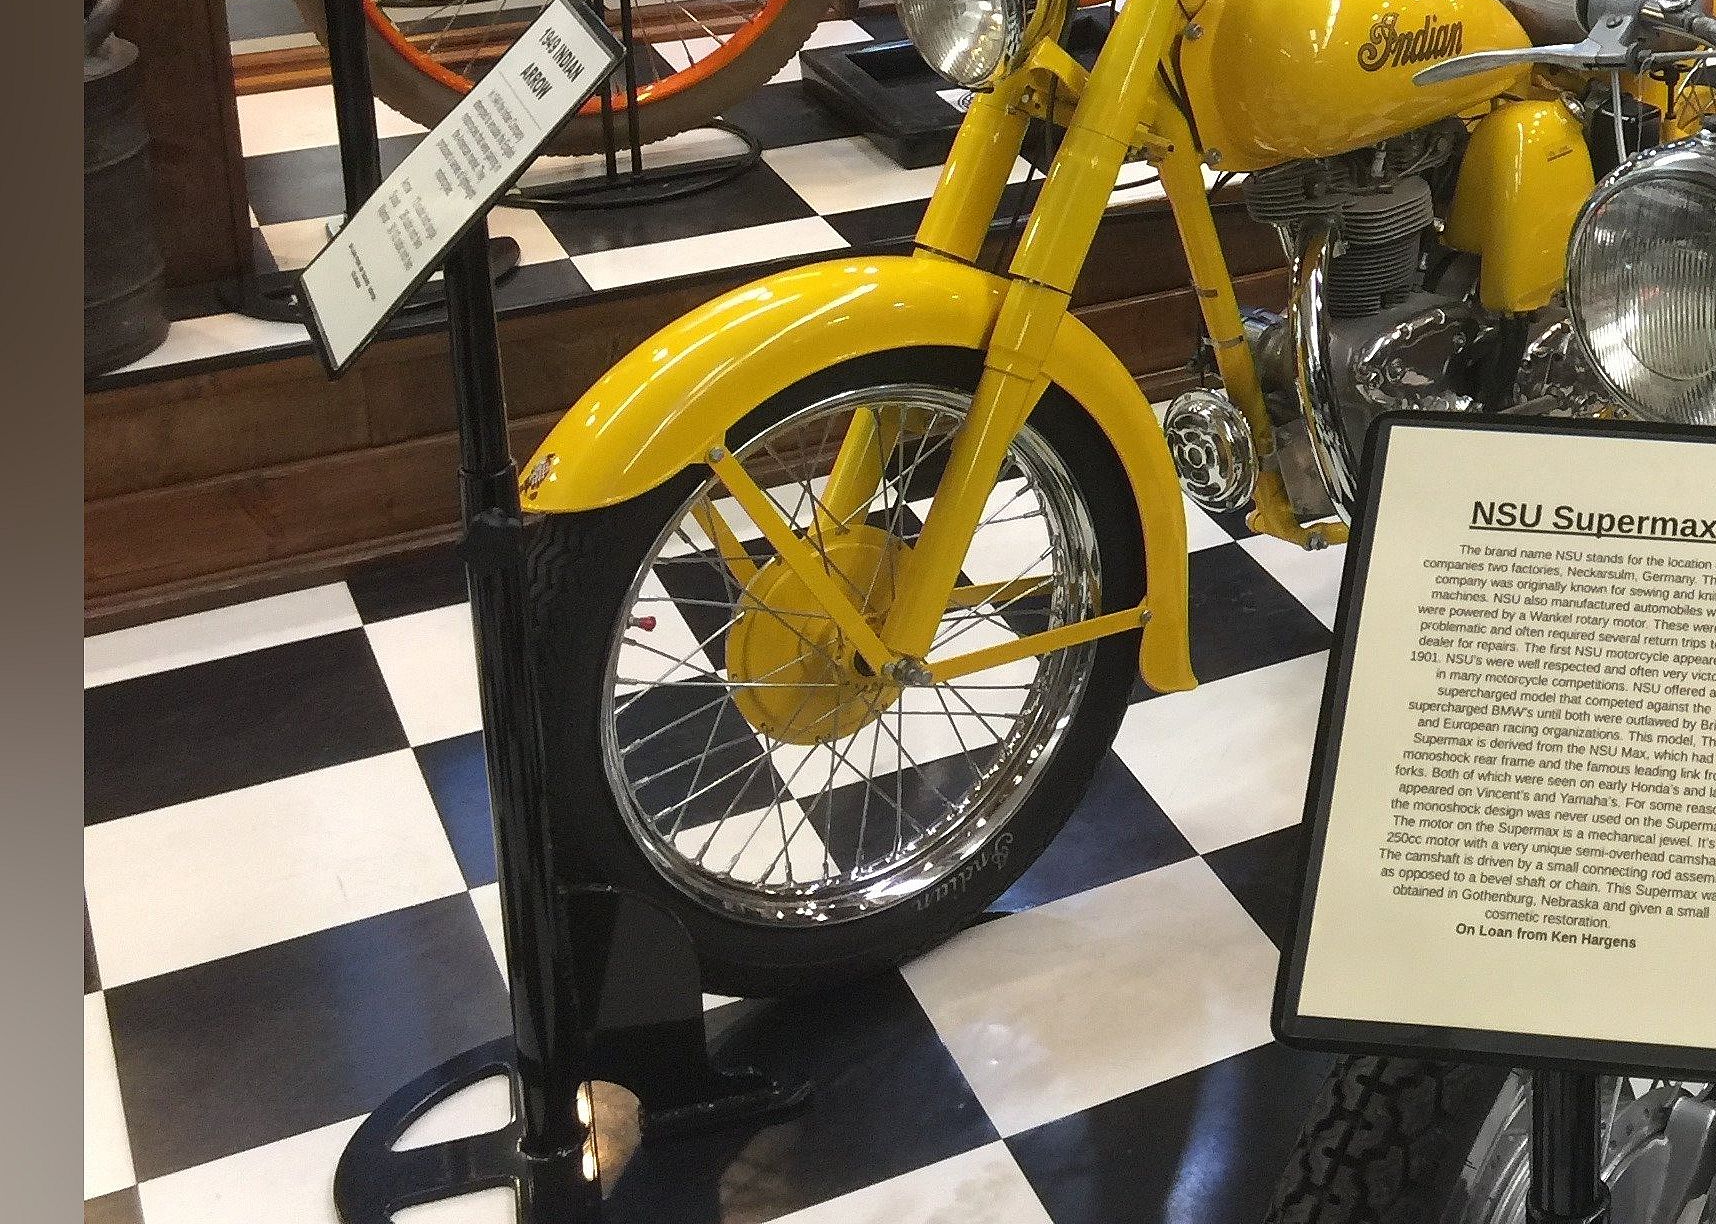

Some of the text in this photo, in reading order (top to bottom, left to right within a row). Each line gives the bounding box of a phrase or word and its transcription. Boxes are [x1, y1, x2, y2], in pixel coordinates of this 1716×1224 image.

[538, 26, 586, 83] 1949 INDIAN
[1357, 11, 1465, 73] Indian
[519, 62, 554, 101] ARROW
[1468, 499, 1544, 530] NSU
[1421, 557, 1486, 573] companies
[1483, 544, 1714, 571] brand name NSU stands location
[1433, 573, 1489, 591] company
[1514, 577, 1569, 596] originally
[1568, 580, 1610, 595] known
[1627, 586, 1671, 603] sewing
[1416, 603, 1448, 617] were
[1447, 606, 1501, 621] powered
[1528, 609, 1575, 625] Wankel
[1574, 614, 1611, 630] rotary
[1652, 617, 1691, 633] These
[1522, 593, 1549, 608] also
[1549, 596, 1632, 613] manufactured
[1632, 602, 1705, 618] automobiles
[1417, 634, 1456, 650] dealer
[1548, 642, 1573, 657] first
[1604, 648, 1671, 665] motorcycle
[1418, 619, 1708, 652] problematic often required several return trips
[1448, 670, 1484, 686] many
[1483, 672, 1550, 689] motorcycle
[1663, 683, 1708, 699] offered
[1484, 656, 1516, 669] were
[1516, 657, 1542, 671] well
[1541, 660, 1603, 675] respected
[1628, 663, 1661, 679] often
[1661, 668, 1690, 684] very
[1406, 700, 1490, 718] supercharged
[1535, 707, 1563, 721] until
[1563, 708, 1592, 723] both
[1592, 712, 1624, 726] were
[1624, 713, 1681, 730] outlawed
[1435, 685, 1691, 715] supercharged model that competed against
[1441, 716, 1501, 734] European
[1501, 722, 1540, 739] racing
[1627, 729, 1655, 745] This
[1411, 731, 1475, 748] Supermax
[1488, 736, 1535, 753] derived
[1535, 739, 1565, 755] from
[1652, 748, 1690, 763] which
[1401, 749, 1472, 765] monoshock
[1472, 754, 1499, 767] rear
[1500, 753, 1537, 769] frame
[1585, 759, 1632, 777] famous
[1632, 762, 1678, 782] leading
[1679, 766, 1703, 781] link
[1430, 765, 1461, 781] Both
[1476, 769, 1513, 784] which
[1513, 773, 1545, 787] were
[1545, 775, 1578, 789] seen
[1597, 778, 1629, 796] early
[1397, 781, 1456, 798] appeared
[1648, 799, 1684, 814] some
[1411, 799, 1483, 816] monoshock
[1482, 803, 1525, 821] design
[1552, 810, 1590, 824] never
[1590, 812, 1623, 826] used
[1417, 817, 1456, 831] motor
[1496, 820, 1561, 839] Supermax
[1586, 828, 1658, 846] mechanical
[1385, 830, 1424, 846] 250cc
[1423, 835, 1463, 849] motor
[1462, 835, 1489, 850] with
[1501, 840, 1530, 856] very
[1530, 842, 1574, 859] unique
[1574, 845, 1667, 864] semi-overhead
[1403, 850, 1462, 866] camshaft
[1475, 853, 1515, 869] driven
[1545, 860, 1581, 875] small
[1580, 863, 1650, 883] connecting
[1397, 867, 1452, 883] opposed
[1478, 870, 1515, 887] bevel
[1514, 874, 1547, 890] shaft
[1604, 880, 1633, 897] This
[1634, 882, 1699, 901] Supermax
[1391, 882, 1446, 900] obtained
[1539, 893, 1601, 912] Nebraska
[1627, 899, 1664, 917] given
[1675, 905, 1711, 920] small
[1483, 908, 1541, 925] cosmetic
[1454, 921, 1638, 951] On Loan from Ken Hargens
